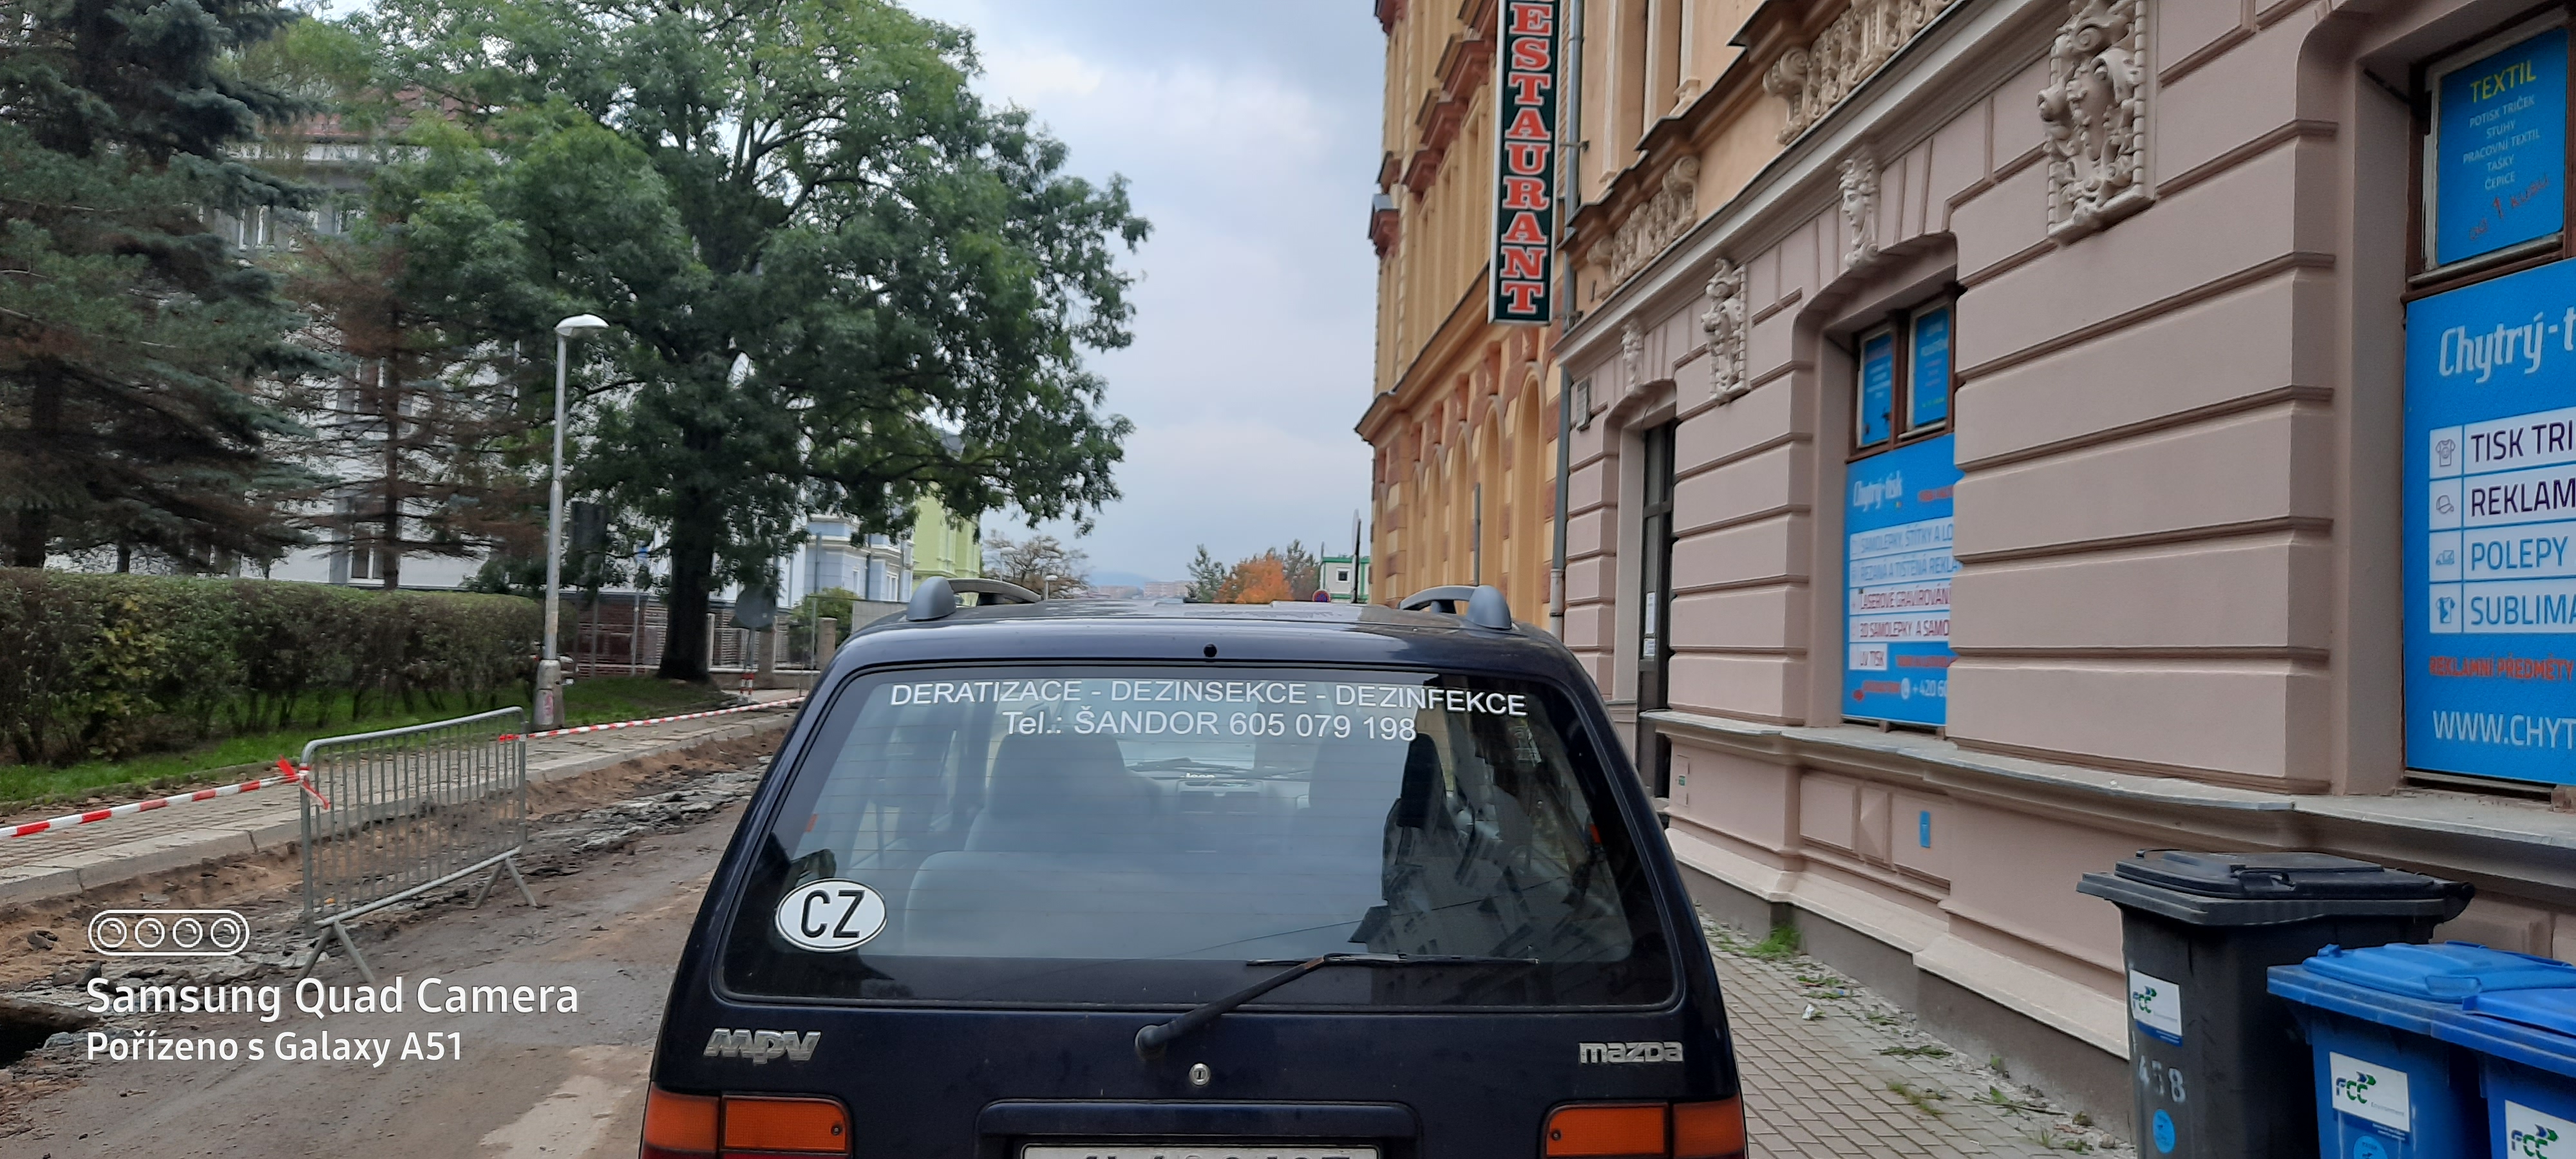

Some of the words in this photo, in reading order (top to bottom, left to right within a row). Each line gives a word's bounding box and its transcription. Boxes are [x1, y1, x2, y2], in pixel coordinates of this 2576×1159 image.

[2470, 59, 2537, 103] TEXTIL
[2469, 107, 2500, 128] POTISK
[2502, 95, 2535, 115] TRIČEK
[2486, 119, 2515, 139] STUHY
[1499, 0, 1553, 314] ESTAURANT
[2463, 135, 2508, 164] PRACOVNÍ
[2511, 128, 2540, 147] TEXTIL
[2471, 427, 2524, 463] TISK
[2532, 419, 2573, 455] TRI
[2471, 477, 2576, 517] REKLAM
[2471, 536, 2568, 571] POLEPY
[1916, 620, 1922, 634] A
[2429, 652, 2495, 677] REKLAMNÍ
[2497, 652, 2575, 681] PŘEDMĚTY
[891, 681, 1083, 706] DERATIZACE
[1111, 680, 1307, 704] DEZINSEKCE
[1336, 684, 1528, 717] DEZINFEKCE
[1002, 711, 1062, 735] Tel.:
[1074, 705, 1220, 735] ŠANDOR
[1229, 712, 1285, 736] 605
[1295, 714, 1351, 739] 079
[1363, 716, 1416, 741] 198
[2432, 710, 2576, 750] WWW.CHYT
[800, 889, 866, 938] CZ
[703, 1028, 821, 1064] MPV
[2336, 1077, 2368, 1104] FCC
[2511, 1129, 2549, 1159] FCC
